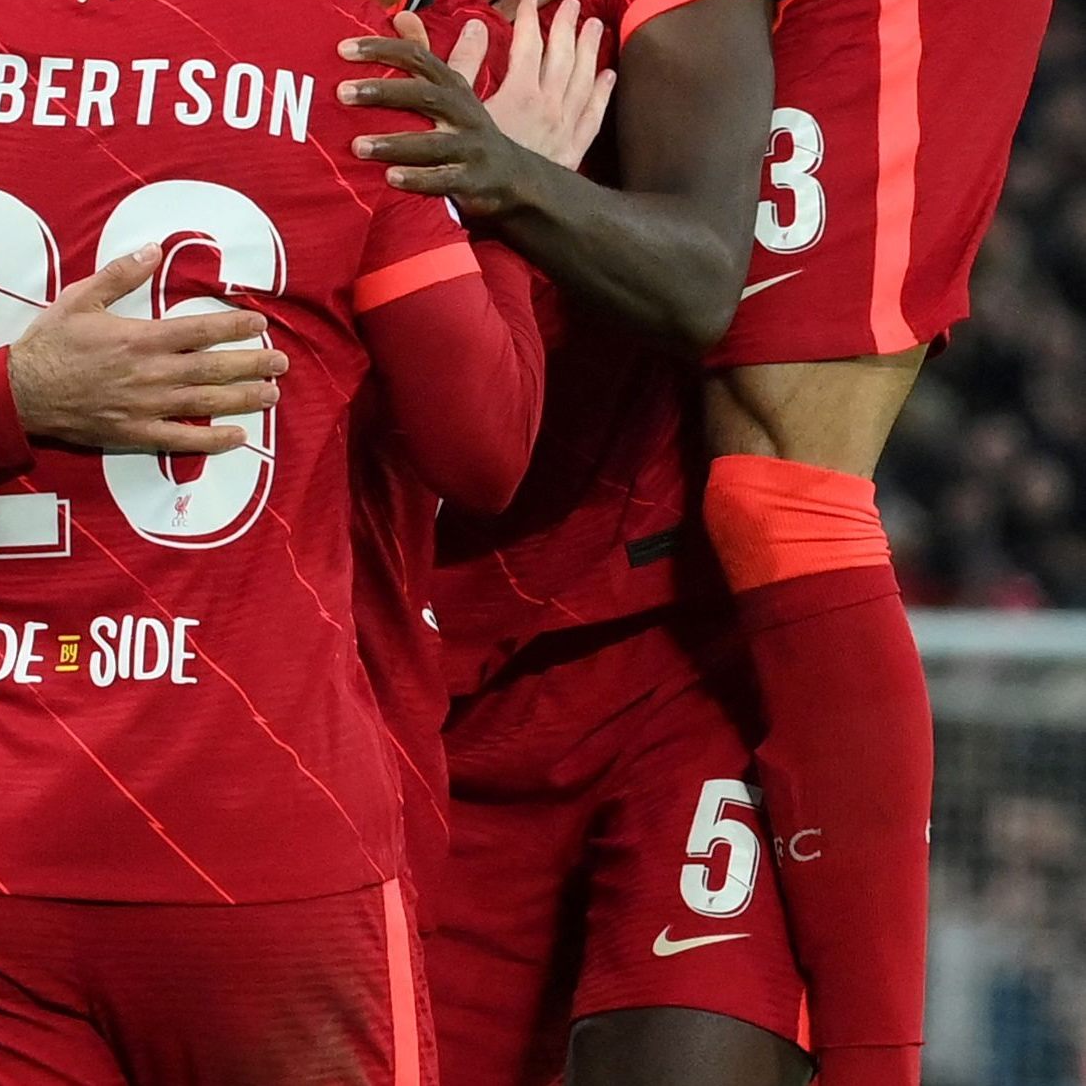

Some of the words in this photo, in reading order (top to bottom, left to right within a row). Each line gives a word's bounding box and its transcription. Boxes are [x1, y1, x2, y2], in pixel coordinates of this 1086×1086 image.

[59, 643, 79, 664] BY
[89, 614, 201, 687] SIDE
[680, 778, 763, 919] 5
